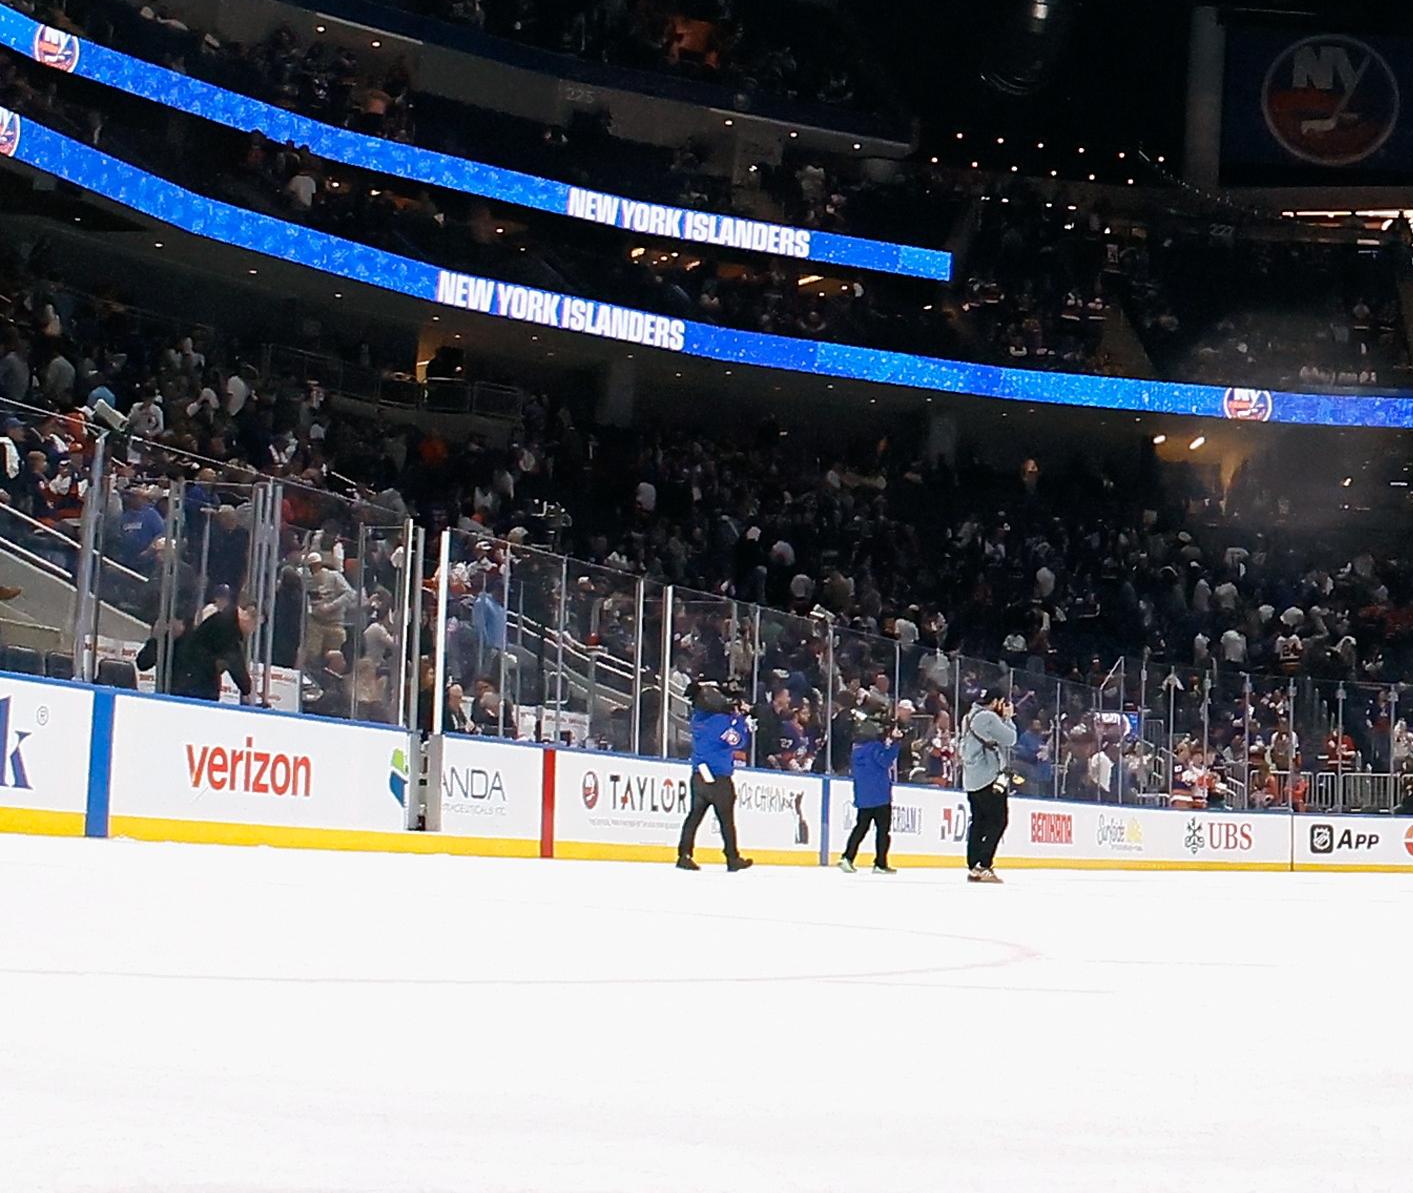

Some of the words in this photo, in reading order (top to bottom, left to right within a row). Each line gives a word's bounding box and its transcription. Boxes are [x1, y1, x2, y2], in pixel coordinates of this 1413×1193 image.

[568, 186, 620, 228] NEW
[620, 198, 682, 238] YORK
[685, 210, 811, 259] ISLANDERS
[437, 270, 496, 311] NEW
[497, 281, 560, 327] YORK
[562, 296, 686, 351] ISLANDERS
[186, 737, 311, 797] verizon
[609, 774, 687, 814] TAYLOR
[1208, 822, 1253, 850] UBS
